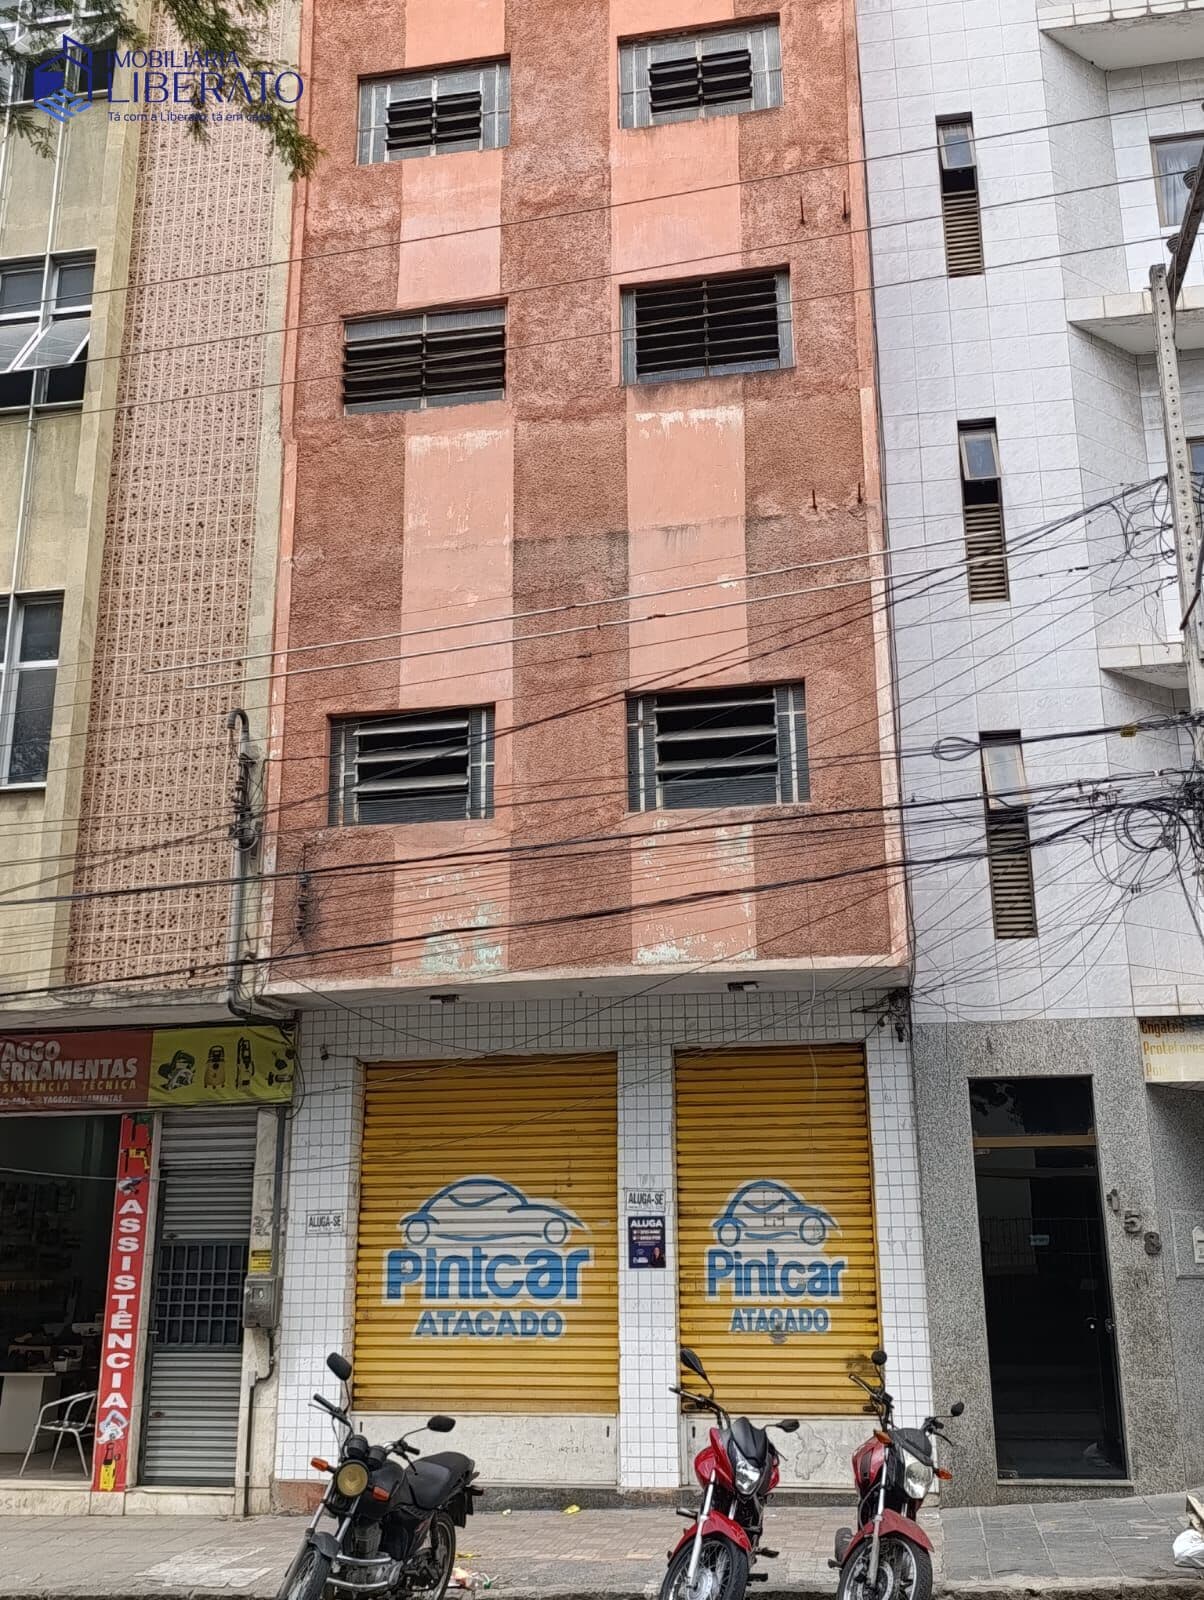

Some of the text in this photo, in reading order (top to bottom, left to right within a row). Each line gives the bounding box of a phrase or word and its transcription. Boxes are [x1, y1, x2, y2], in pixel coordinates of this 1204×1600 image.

[628, 1192, 664, 1205] ALUGA-SE
[309, 1215, 341, 1227] ALUGA-SE
[630, 1219, 663, 1228] ALUGA
[386, 1246, 591, 1300] Pintcar
[707, 1248, 845, 1297] Pintcar
[101, 1199, 143, 1409] ASSISTÊNCIA
[414, 1310, 565, 1338] ATACADO
[730, 1307, 830, 1333] ATACADO
